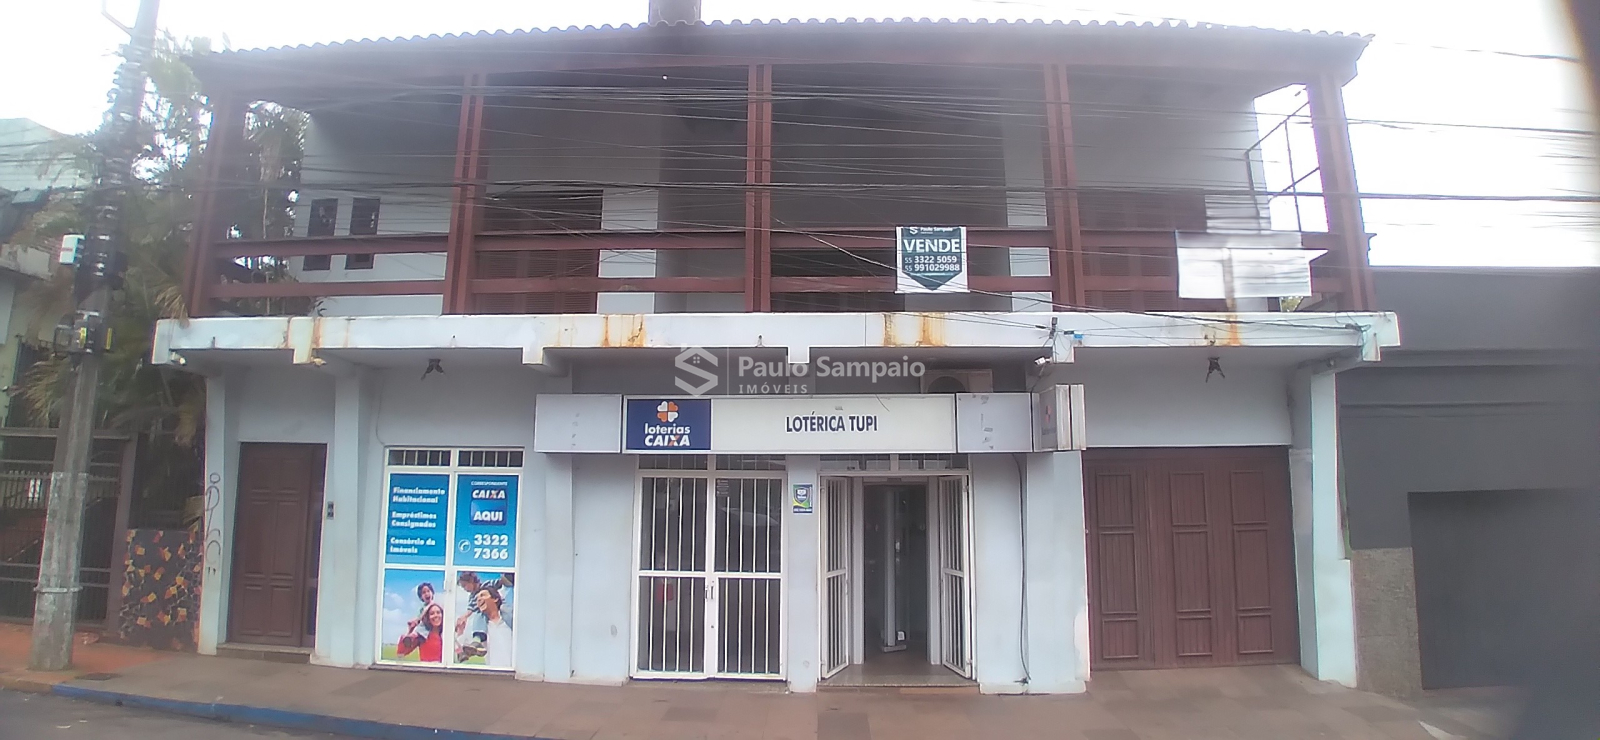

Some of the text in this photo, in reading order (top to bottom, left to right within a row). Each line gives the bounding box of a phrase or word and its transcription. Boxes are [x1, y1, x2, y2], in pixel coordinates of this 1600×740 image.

[903, 239, 961, 253] VENDE
[914, 255, 935, 264] 3322
[936, 255, 958, 264] 5059
[914, 264, 960, 272] 991029988
[786, 411, 878, 432] LOTÉRICA TUPI
[644, 422, 691, 435] loterias
[644, 434, 691, 447] CAIXA
[472, 489, 506, 499] CAIXA
[473, 511, 503, 521] AQUI
[474, 534, 509, 546] 3322
[473, 548, 509, 560] 7366
